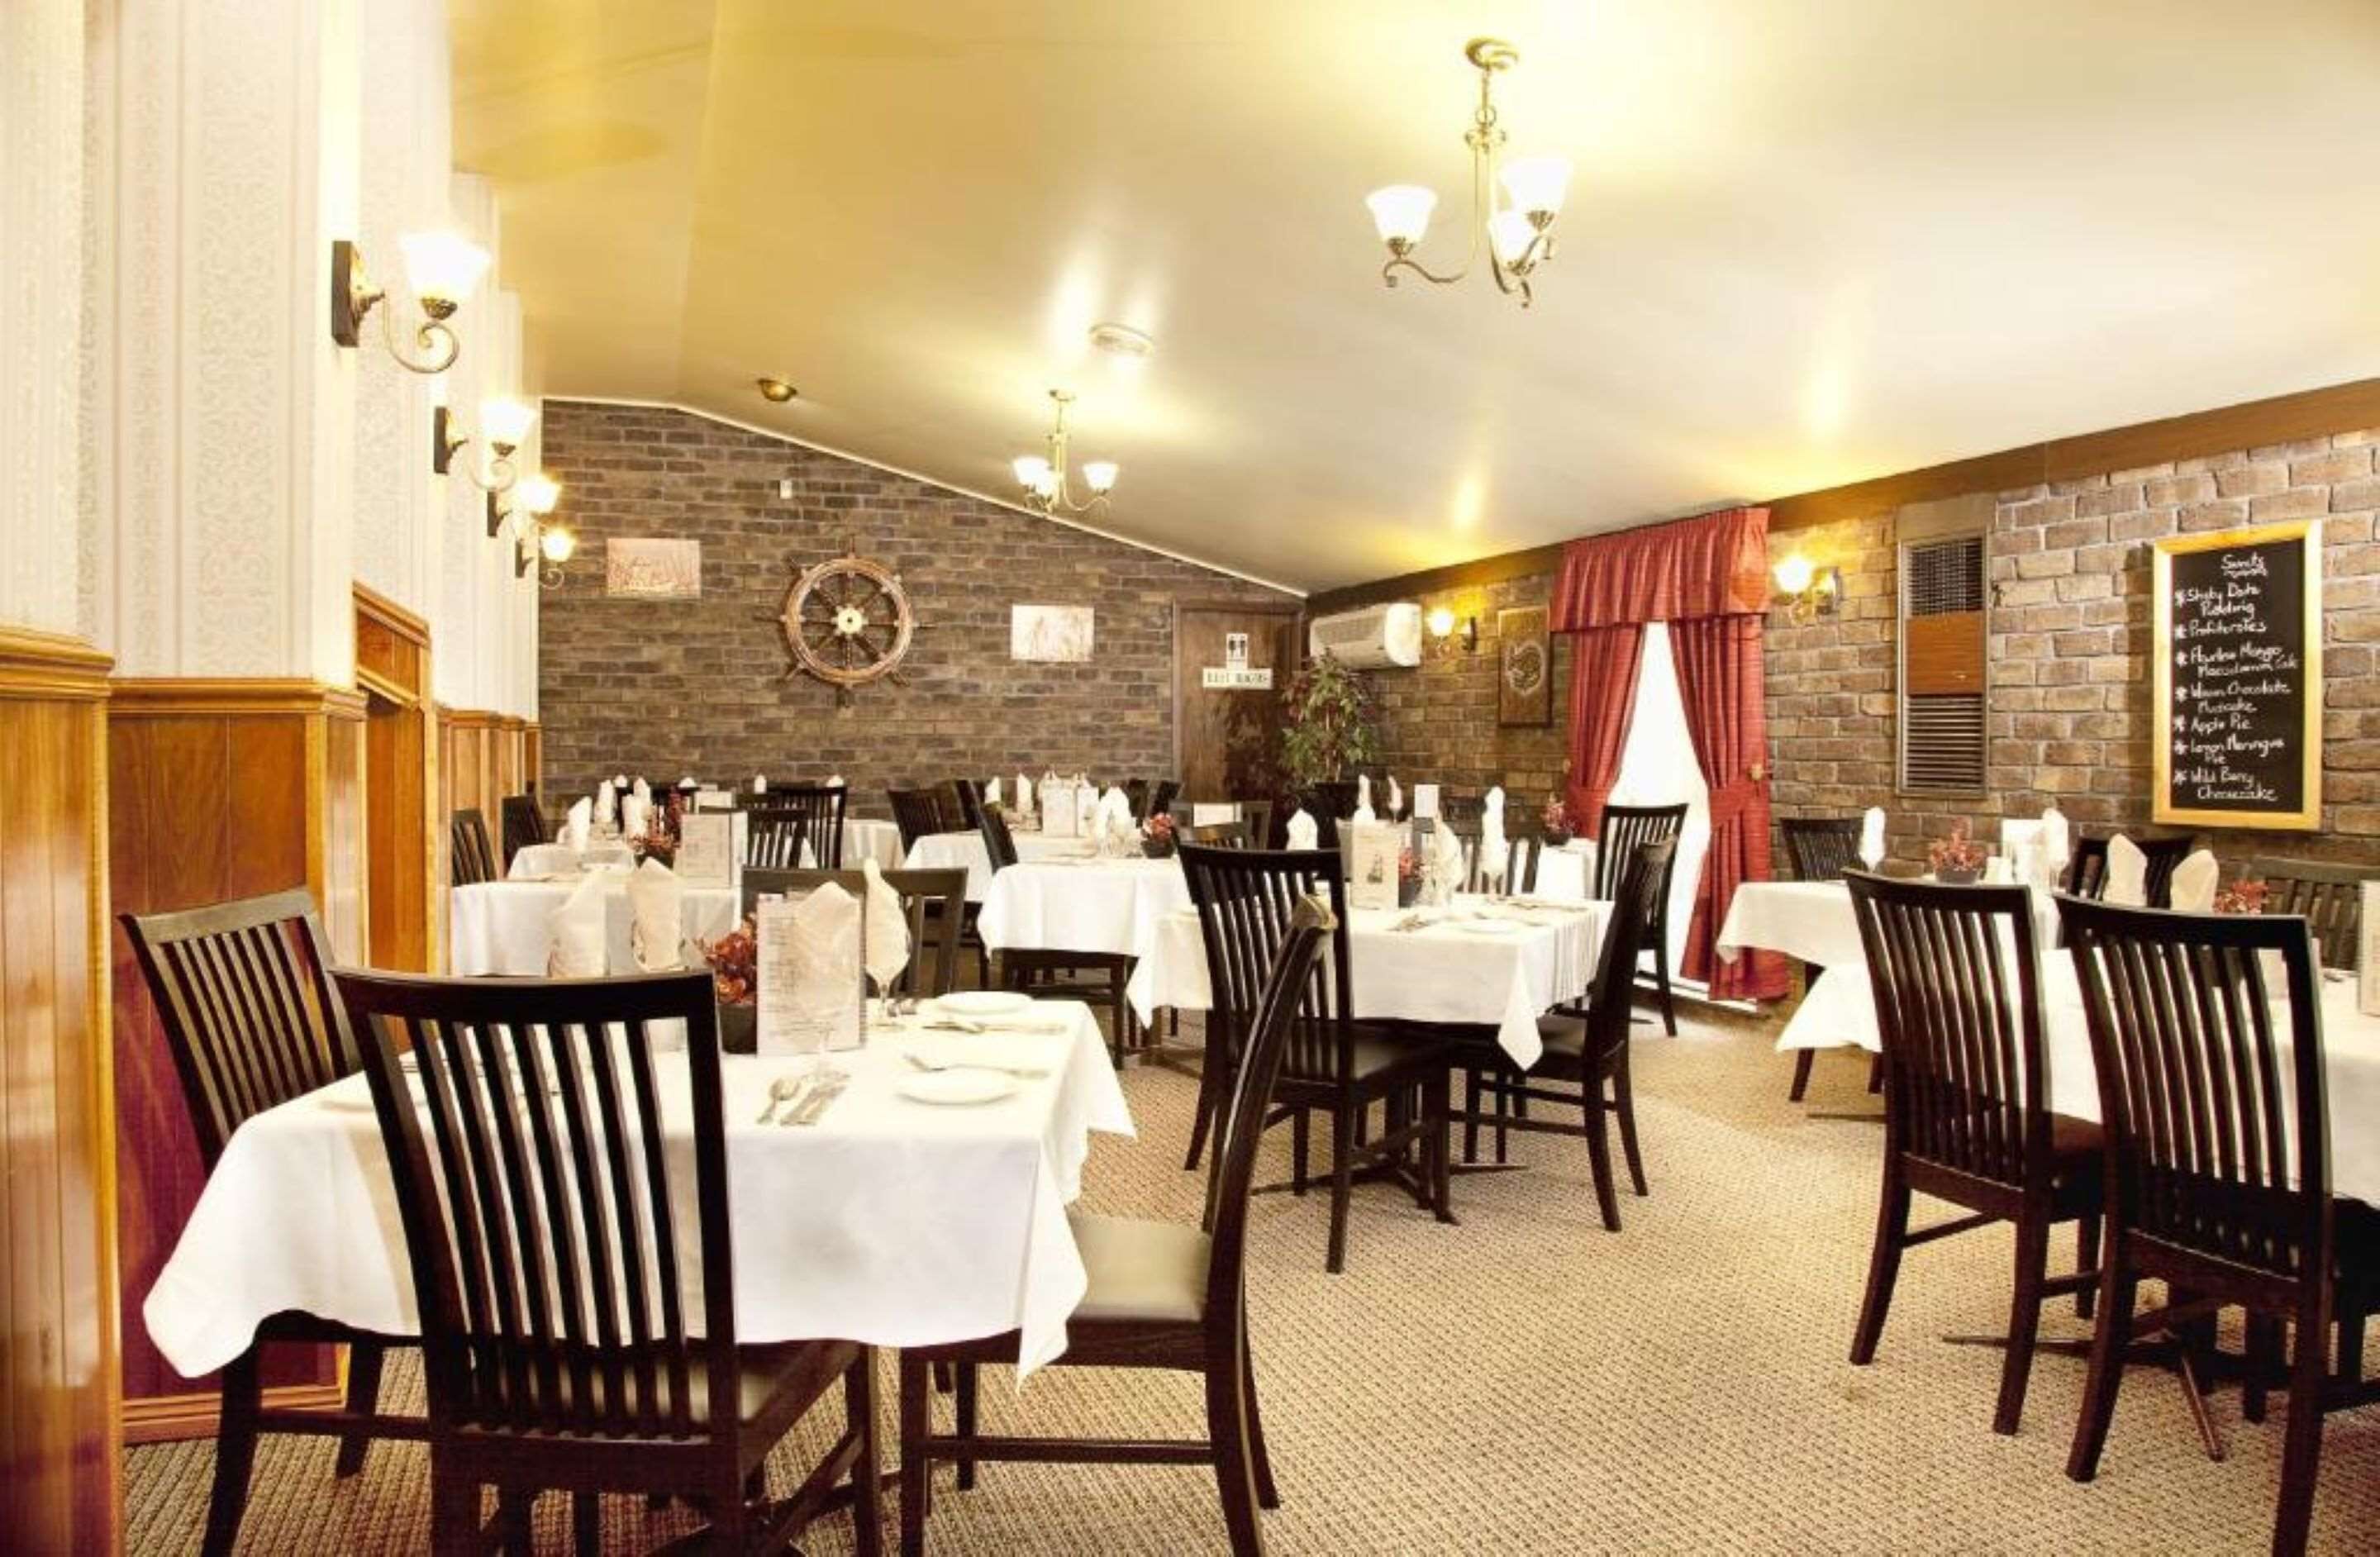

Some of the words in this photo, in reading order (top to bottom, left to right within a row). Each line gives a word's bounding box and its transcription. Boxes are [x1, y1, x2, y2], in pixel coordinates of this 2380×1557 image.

[2191, 717, 2225, 736] Apple
[2230, 712, 2252, 729] Pie
[2191, 739, 2225, 753] Lemon
